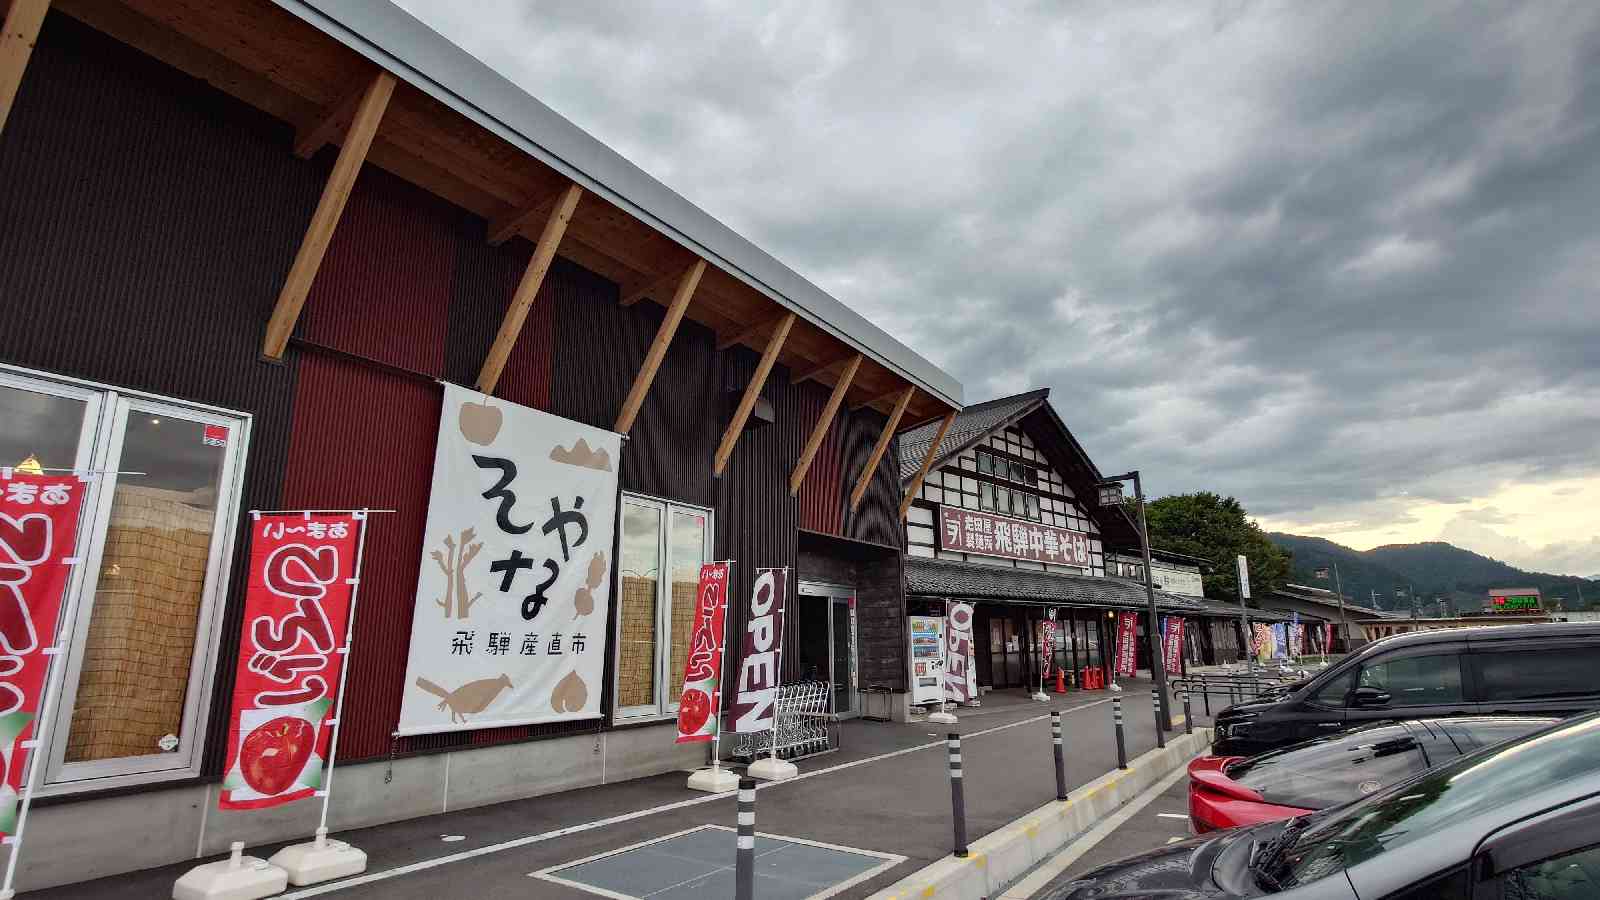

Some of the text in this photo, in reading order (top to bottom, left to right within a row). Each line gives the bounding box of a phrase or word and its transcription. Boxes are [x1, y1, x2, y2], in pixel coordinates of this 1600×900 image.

[451, 630, 587, 656] 飛騨産直市
[735, 571, 775, 733] OPEN
